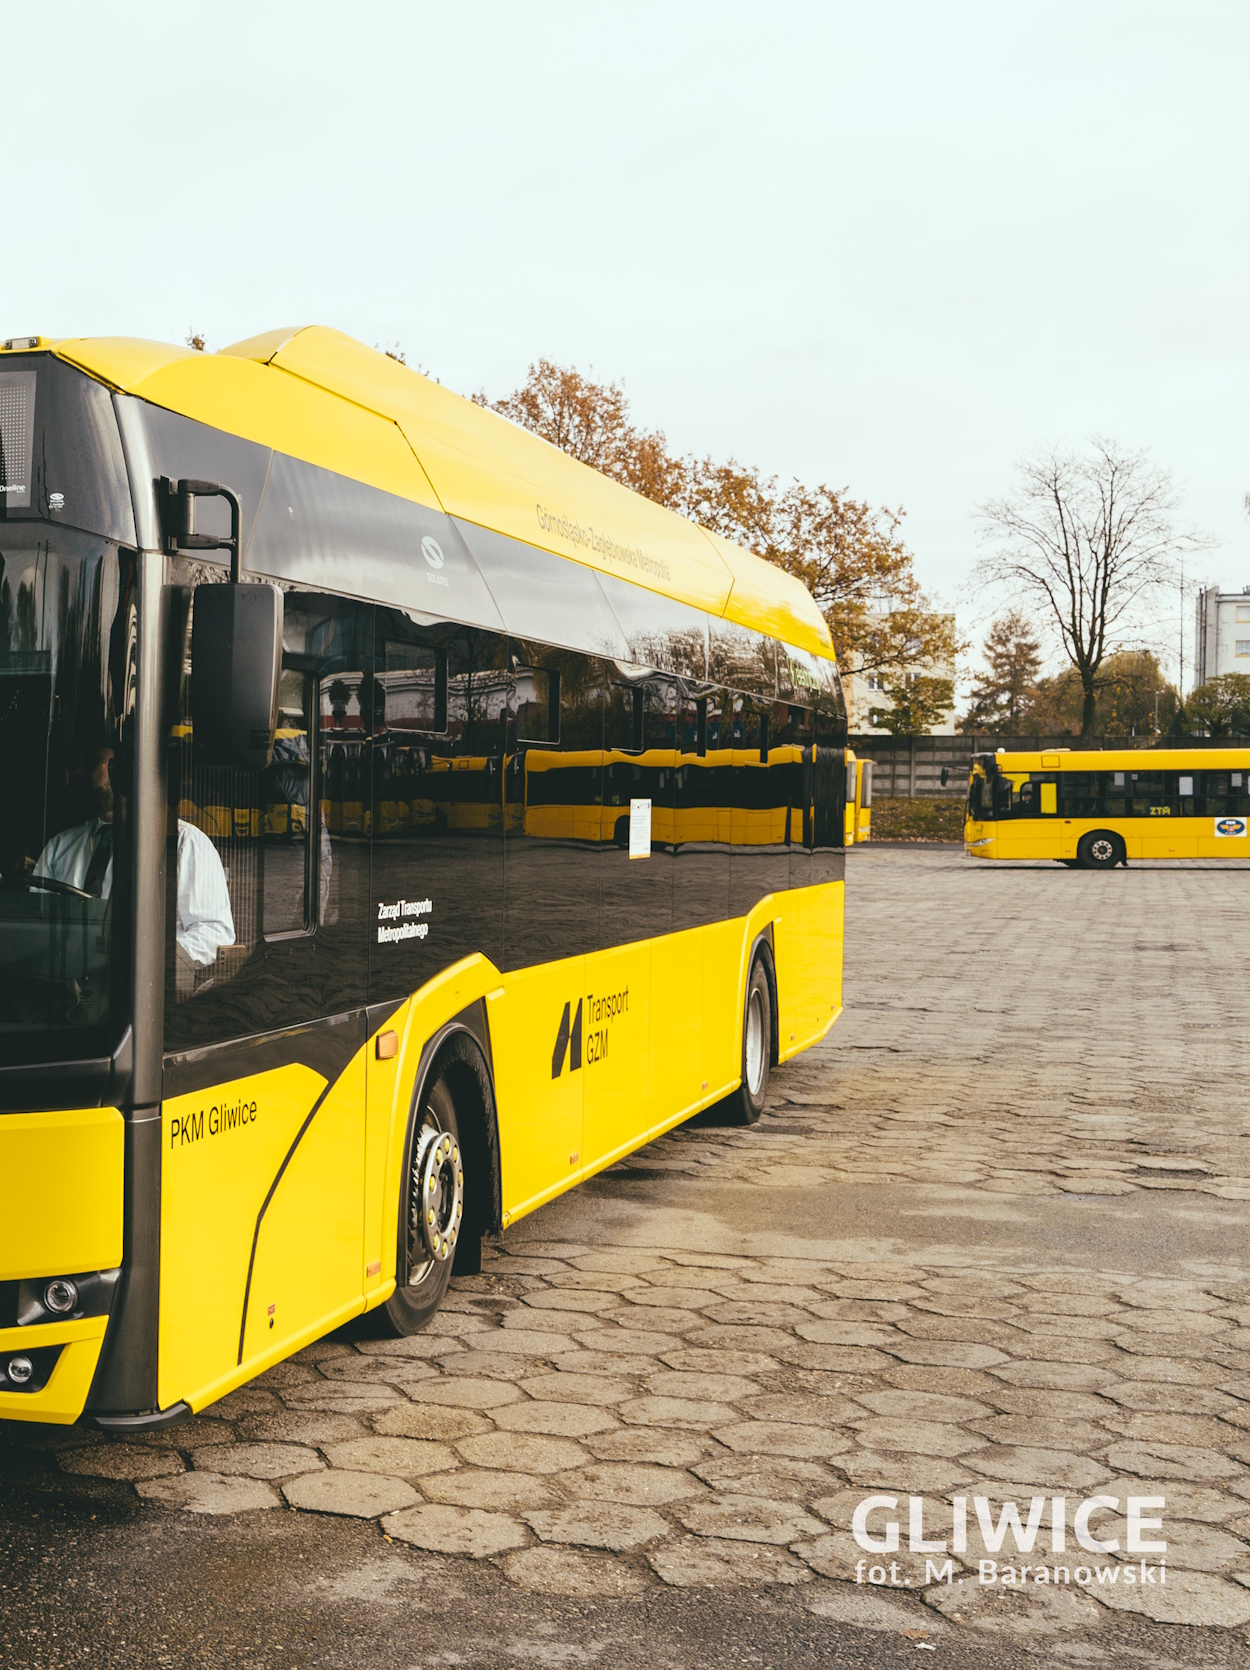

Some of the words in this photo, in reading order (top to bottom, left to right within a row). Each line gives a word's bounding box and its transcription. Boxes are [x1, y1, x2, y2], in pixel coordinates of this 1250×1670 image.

[1150, 806, 1171, 816] ZTM
[378, 900, 400, 921] Zarząd
[400, 898, 433, 917] Transportu
[377, 922, 429, 943] Metropolitalnego
[587, 985, 628, 1024] Transport
[587, 1028, 608, 1064] GZM
[171, 1110, 204, 1149] PKM
[208, 1098, 258, 1136] Gliwice
